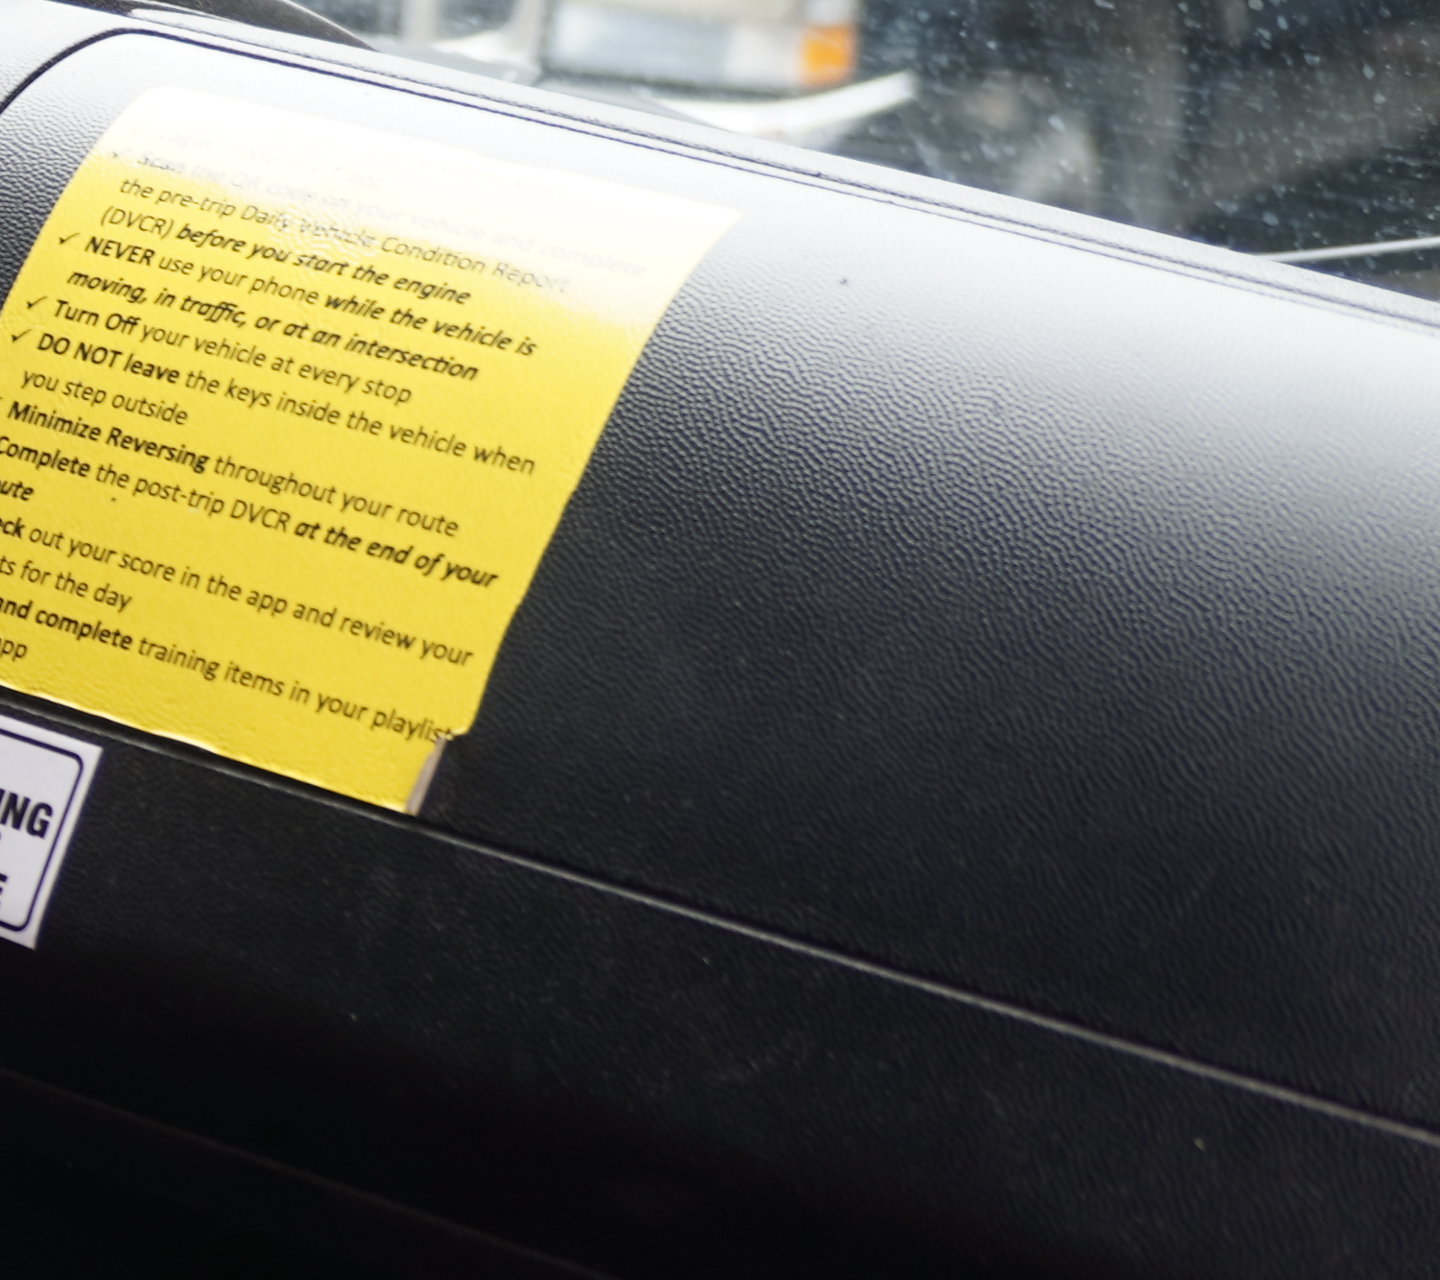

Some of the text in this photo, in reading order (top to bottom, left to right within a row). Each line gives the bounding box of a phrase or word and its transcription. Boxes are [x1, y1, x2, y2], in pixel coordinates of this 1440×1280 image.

[99, 205, 472, 305] (DVCR) before you start the engine
[118, 177, 155, 199] the
[152, 188, 238, 220] pre-trip
[378, 235, 487, 275] Condition
[490, 260, 569, 294] Report
[538, 240, 648, 279] complete
[53, 297, 412, 406] Turn Off your vehicle at every stop
[65, 270, 480, 381] moving, in traffic, or at an intersection
[83, 235, 538, 356] NEVER use your phone while the vehicle is
[19, 369, 189, 426] you step outside
[35, 331, 536, 475] DO NOT leave the keys inside the vehicle when
[5, 399, 460, 538] Minimize Reversing throughout your route
[94, 463, 131, 489] the
[131, 476, 226, 518] post-trip
[228, 498, 292, 533] DVCR
[292, 520, 322, 541] at
[322, 525, 363, 552] the
[364, 540, 415, 565] end
[412, 552, 446, 577] of
[438, 560, 500, 588] your
[18, 559, 52, 585] for
[53, 571, 89, 598] the
[92, 582, 133, 613] day
[27, 526, 65, 551] out
[65, 537, 118, 564] your
[116, 551, 177, 582] score
[178, 565, 201, 589] in
[205, 574, 243, 602] the
[244, 589, 288, 617] app
[291, 602, 338, 628] and
[338, 616, 417, 651] review
[418, 638, 474, 666] your
[33, 608, 134, 651] complete
[137, 636, 221, 682] training
[223, 660, 285, 697] items
[288, 679, 311, 705] in
[314, 692, 369, 721] your
